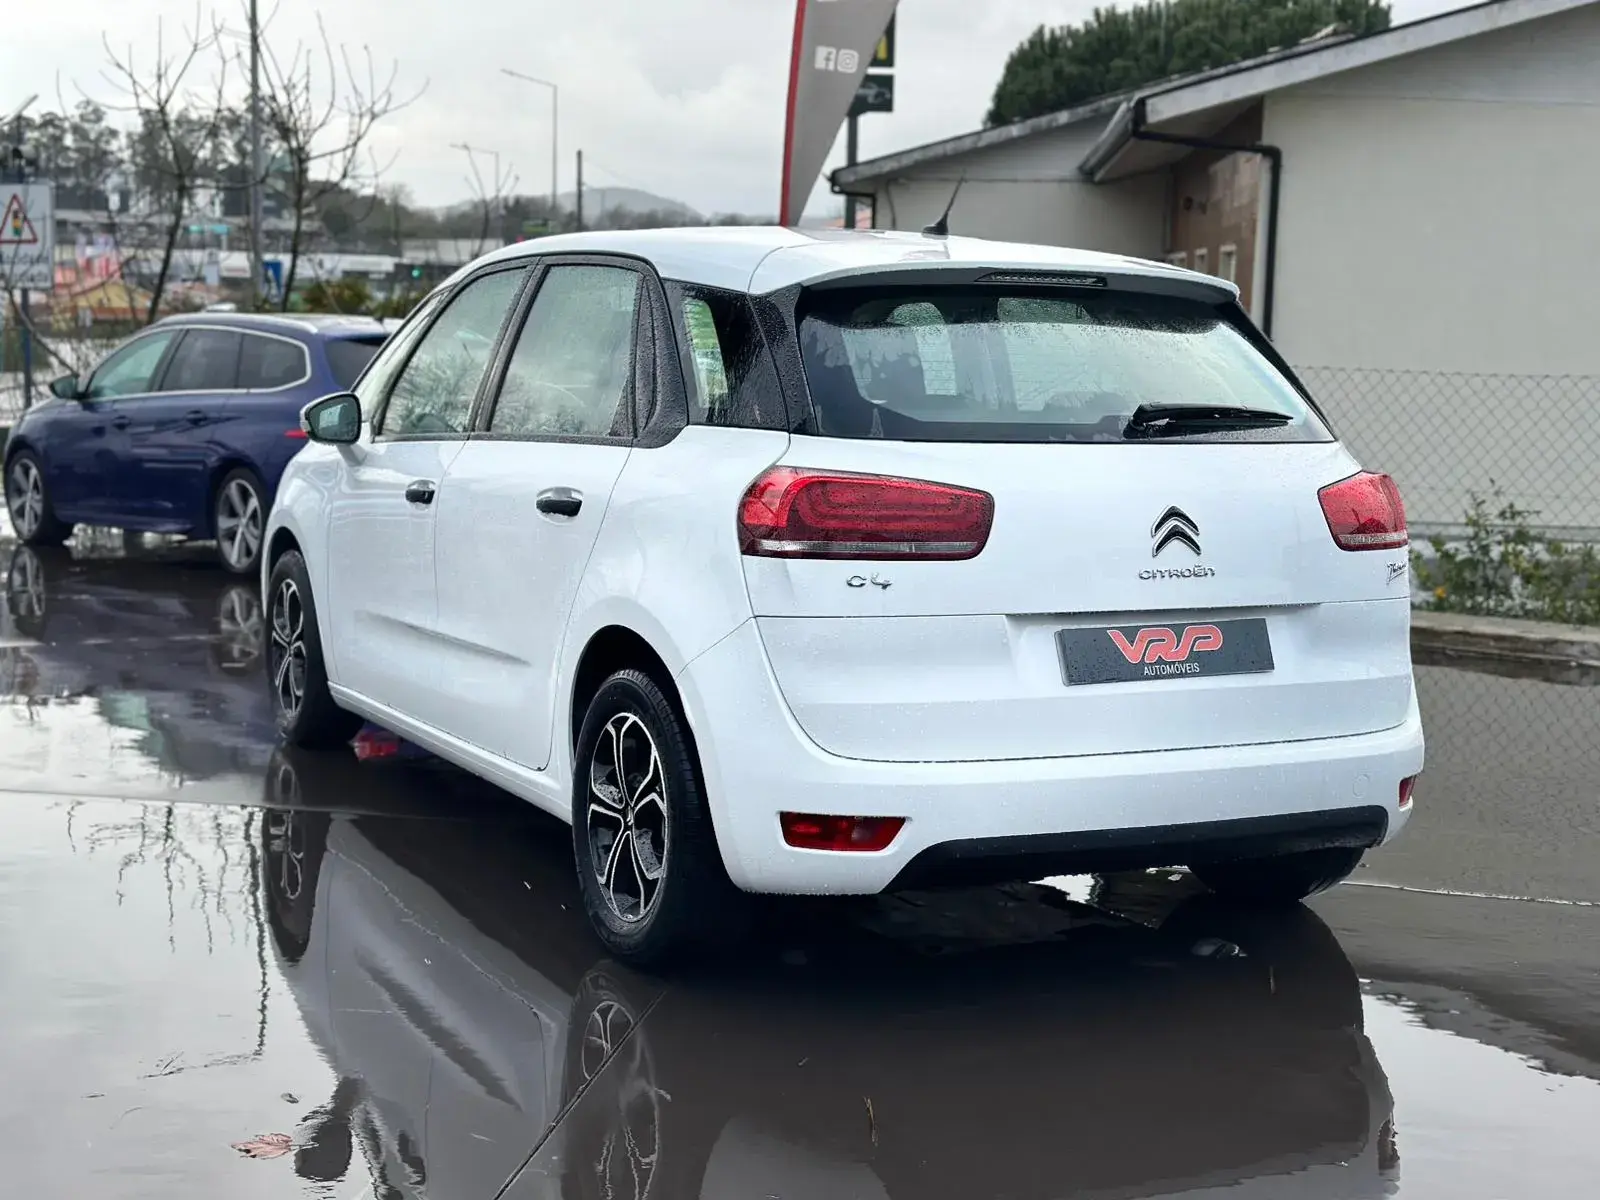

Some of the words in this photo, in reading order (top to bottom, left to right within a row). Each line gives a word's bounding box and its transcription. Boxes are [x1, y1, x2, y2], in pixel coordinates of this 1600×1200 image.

[846, 572, 893, 590] C4
[1107, 624, 1223, 664] VRP
[1143, 662, 1200, 676] AUTOMÓVEIS
